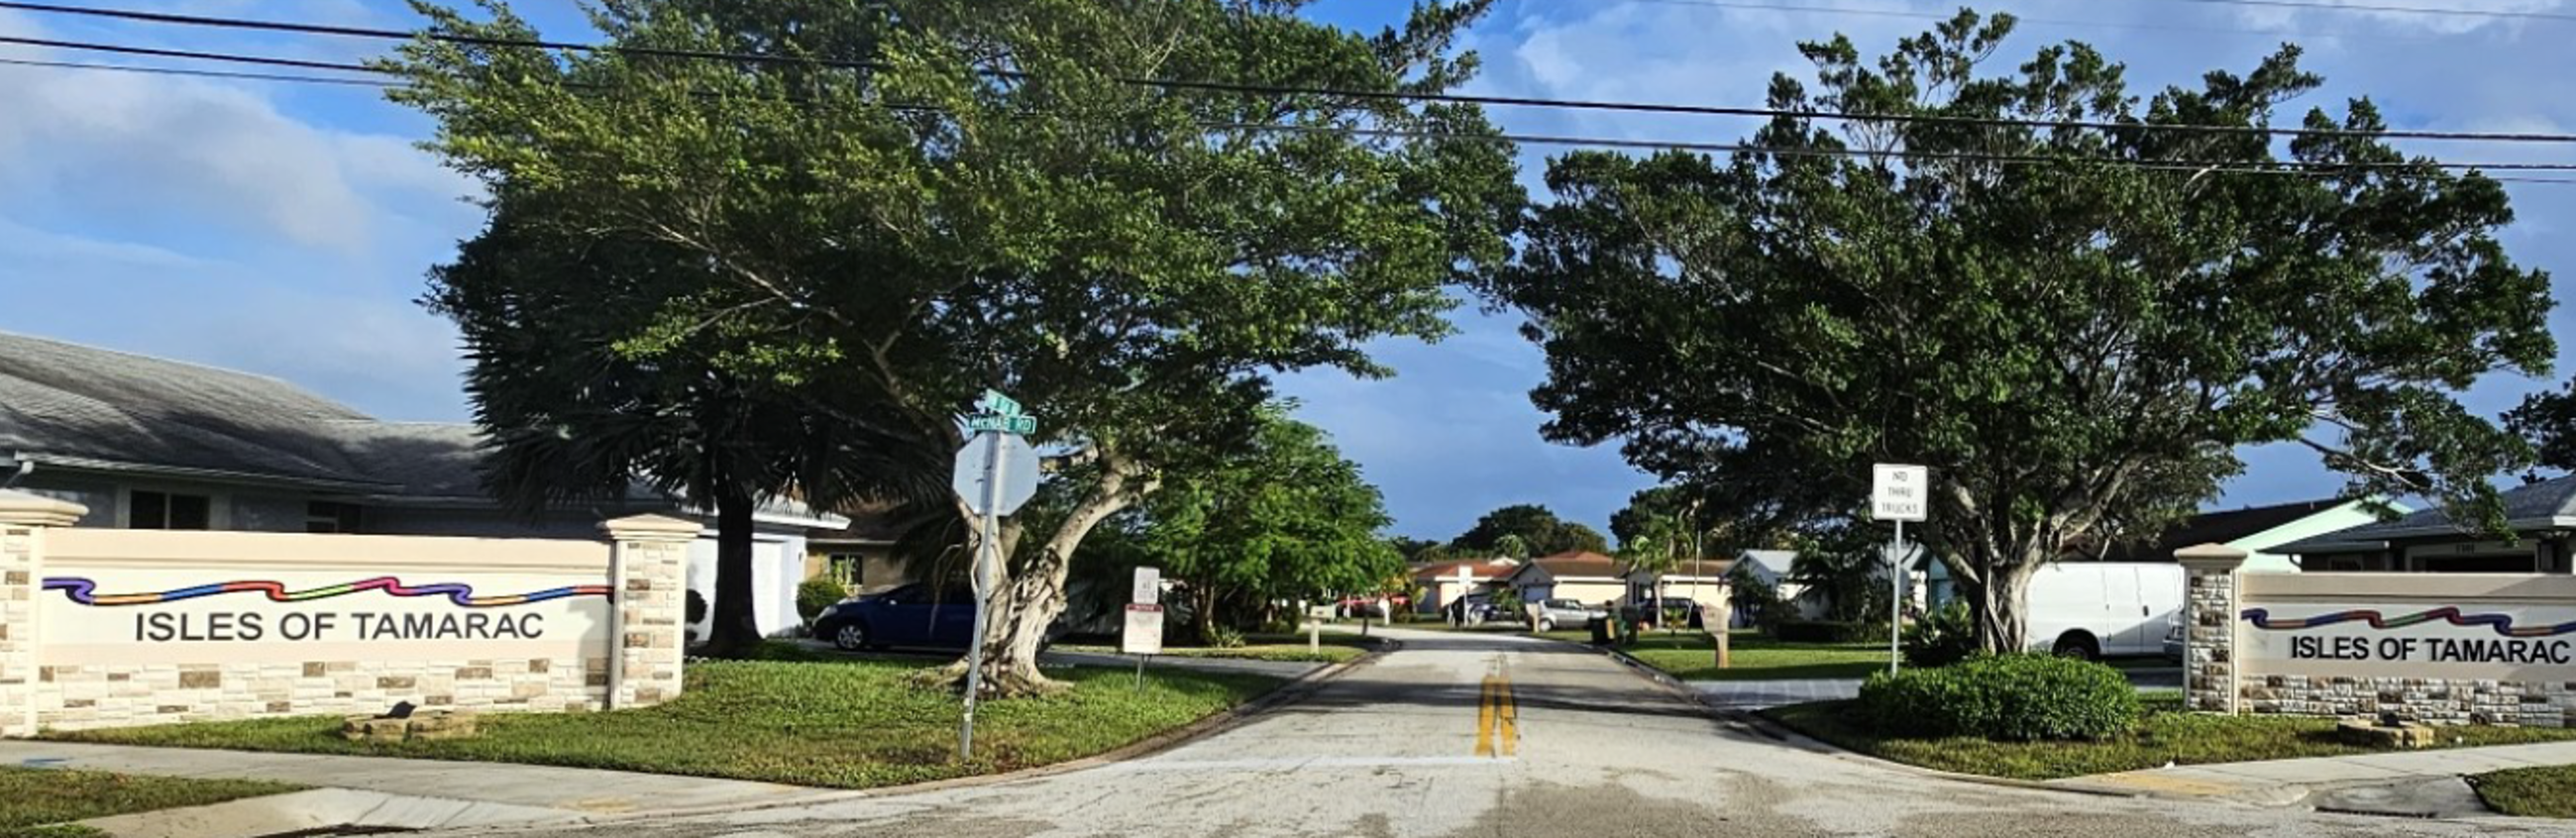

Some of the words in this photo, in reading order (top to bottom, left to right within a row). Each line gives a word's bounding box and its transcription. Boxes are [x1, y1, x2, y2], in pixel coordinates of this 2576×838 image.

[1016, 417, 1031, 431] RD
[1892, 471, 1908, 481] NO
[1887, 486, 1913, 497] THRU
[1881, 502, 1918, 514] TRUCKS
[136, 612, 263, 641] ISLES
[279, 612, 336, 641] OF
[352, 612, 544, 640] TAMARAC
[2291, 636, 2369, 661] ISLES
[2378, 637, 2417, 662] OF
[2426, 638, 2570, 665] TAMARAC
